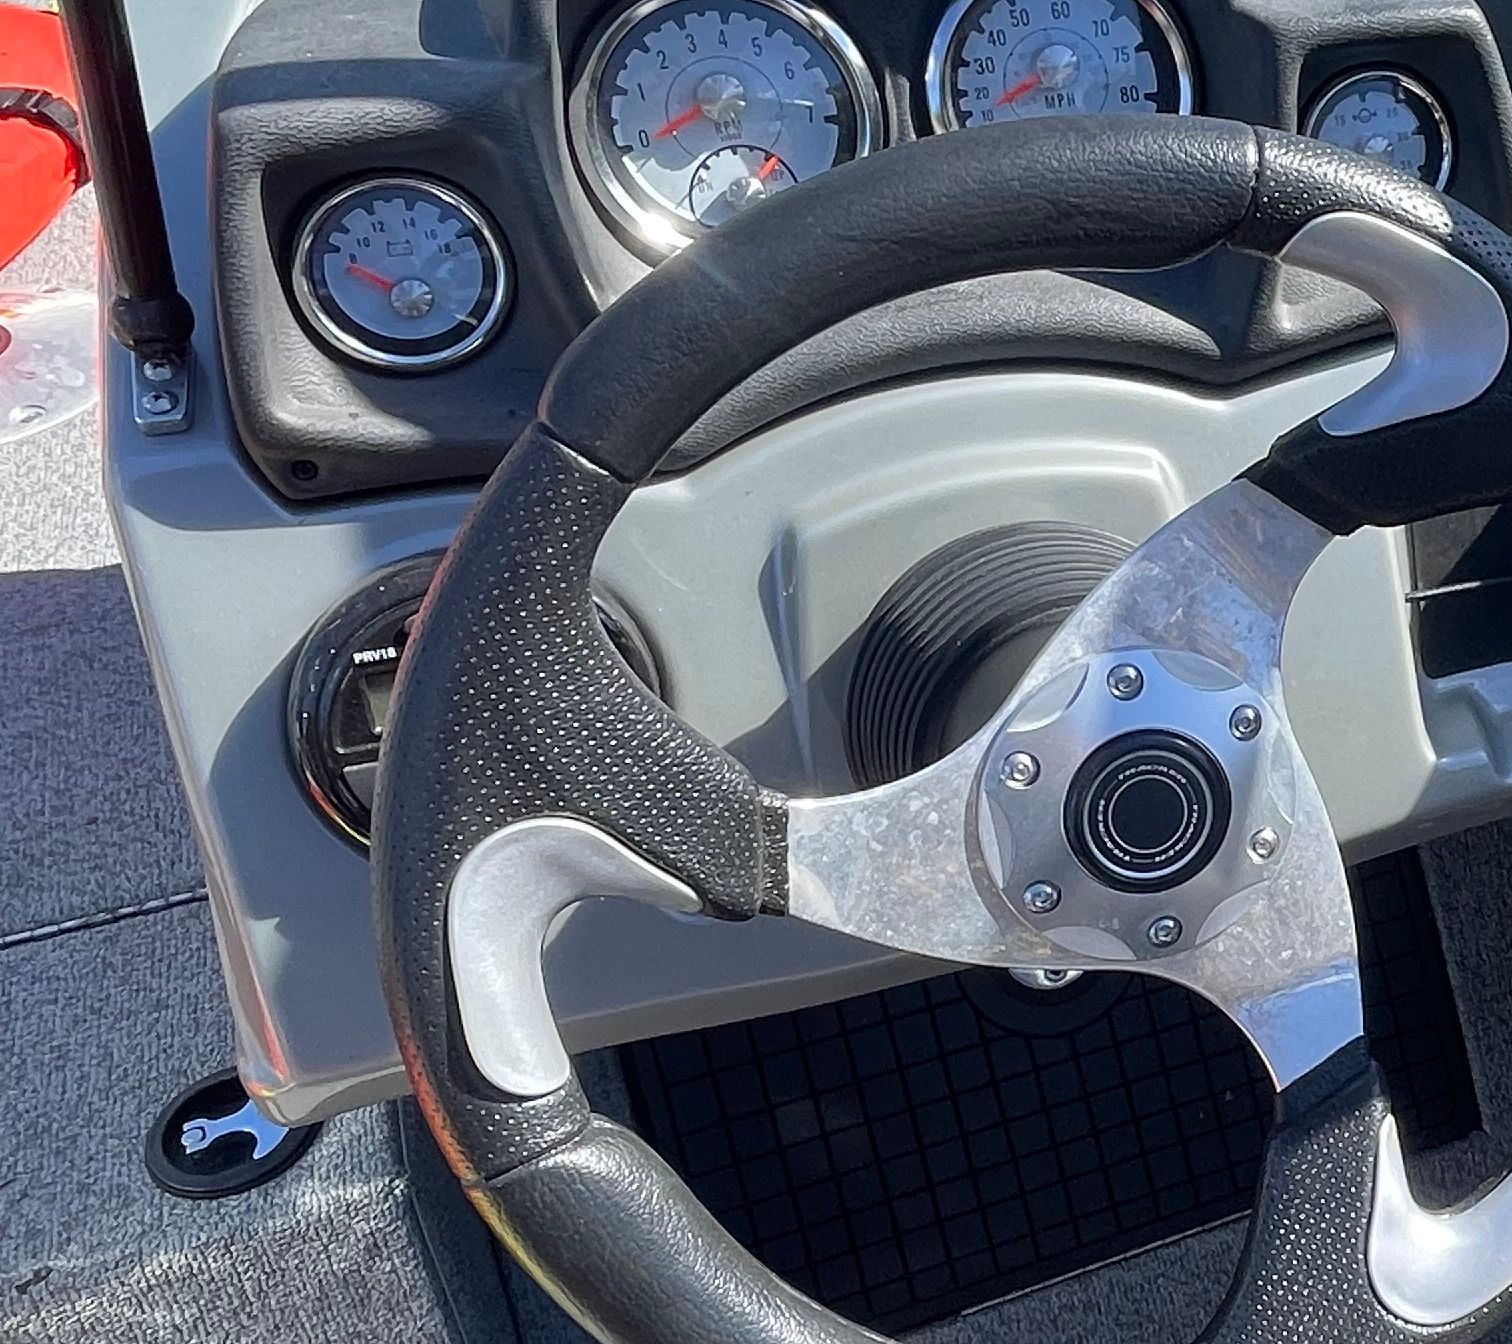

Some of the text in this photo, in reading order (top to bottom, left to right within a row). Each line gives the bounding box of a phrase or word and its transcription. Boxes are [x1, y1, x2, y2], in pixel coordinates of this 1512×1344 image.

[1008, 8, 1030, 27] 50
[1051, 1, 1071, 20] 60
[1092, 19, 1111, 37] 70
[684, 33, 697, 53] 3
[718, 29, 729, 50] 4
[752, 36, 763, 57] 5
[986, 29, 1007, 47] 40
[656, 50, 669, 70] 2
[1113, 46, 1130, 64] 75
[784, 61, 795, 80] 6
[973, 56, 996, 75] 30
[637, 82, 646, 101] 1
[974, 87, 990, 100] 20
[1119, 85, 1140, 104] 80
[1044, 93, 1076, 110] MPH
[980, 108, 994, 122] 10
[713, 118, 744, 137] RPM
[638, 129, 650, 148] 0
[371, 221, 386, 233] 12
[402, 217, 416, 229] 14
[356, 237, 371, 248] 10
[424, 229, 438, 240] 16
[438, 243, 451, 254] 18
